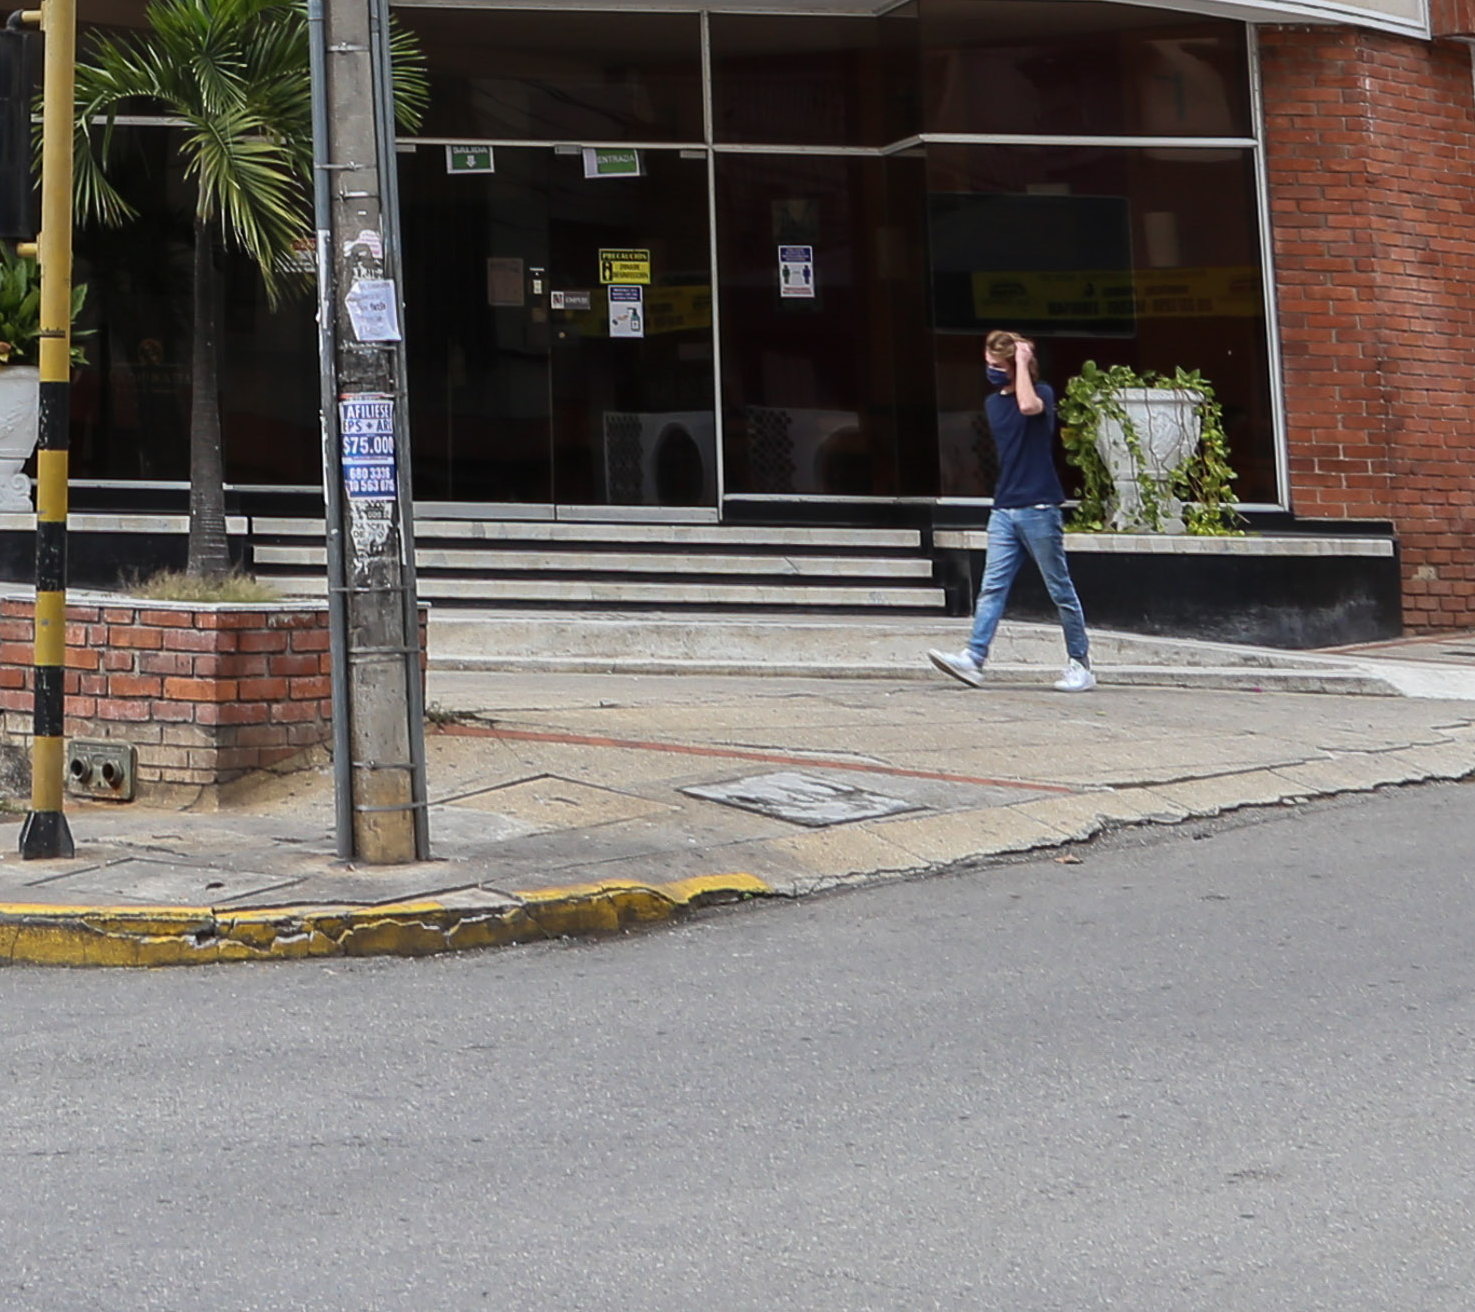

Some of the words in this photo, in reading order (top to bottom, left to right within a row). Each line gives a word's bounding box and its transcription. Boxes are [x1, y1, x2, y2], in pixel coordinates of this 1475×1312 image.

[452, 145, 489, 154] SALIDA
[347, 404, 389, 418] AFILIESE
[343, 419, 362, 432] EPS
[342, 436, 394, 456] $75.000
